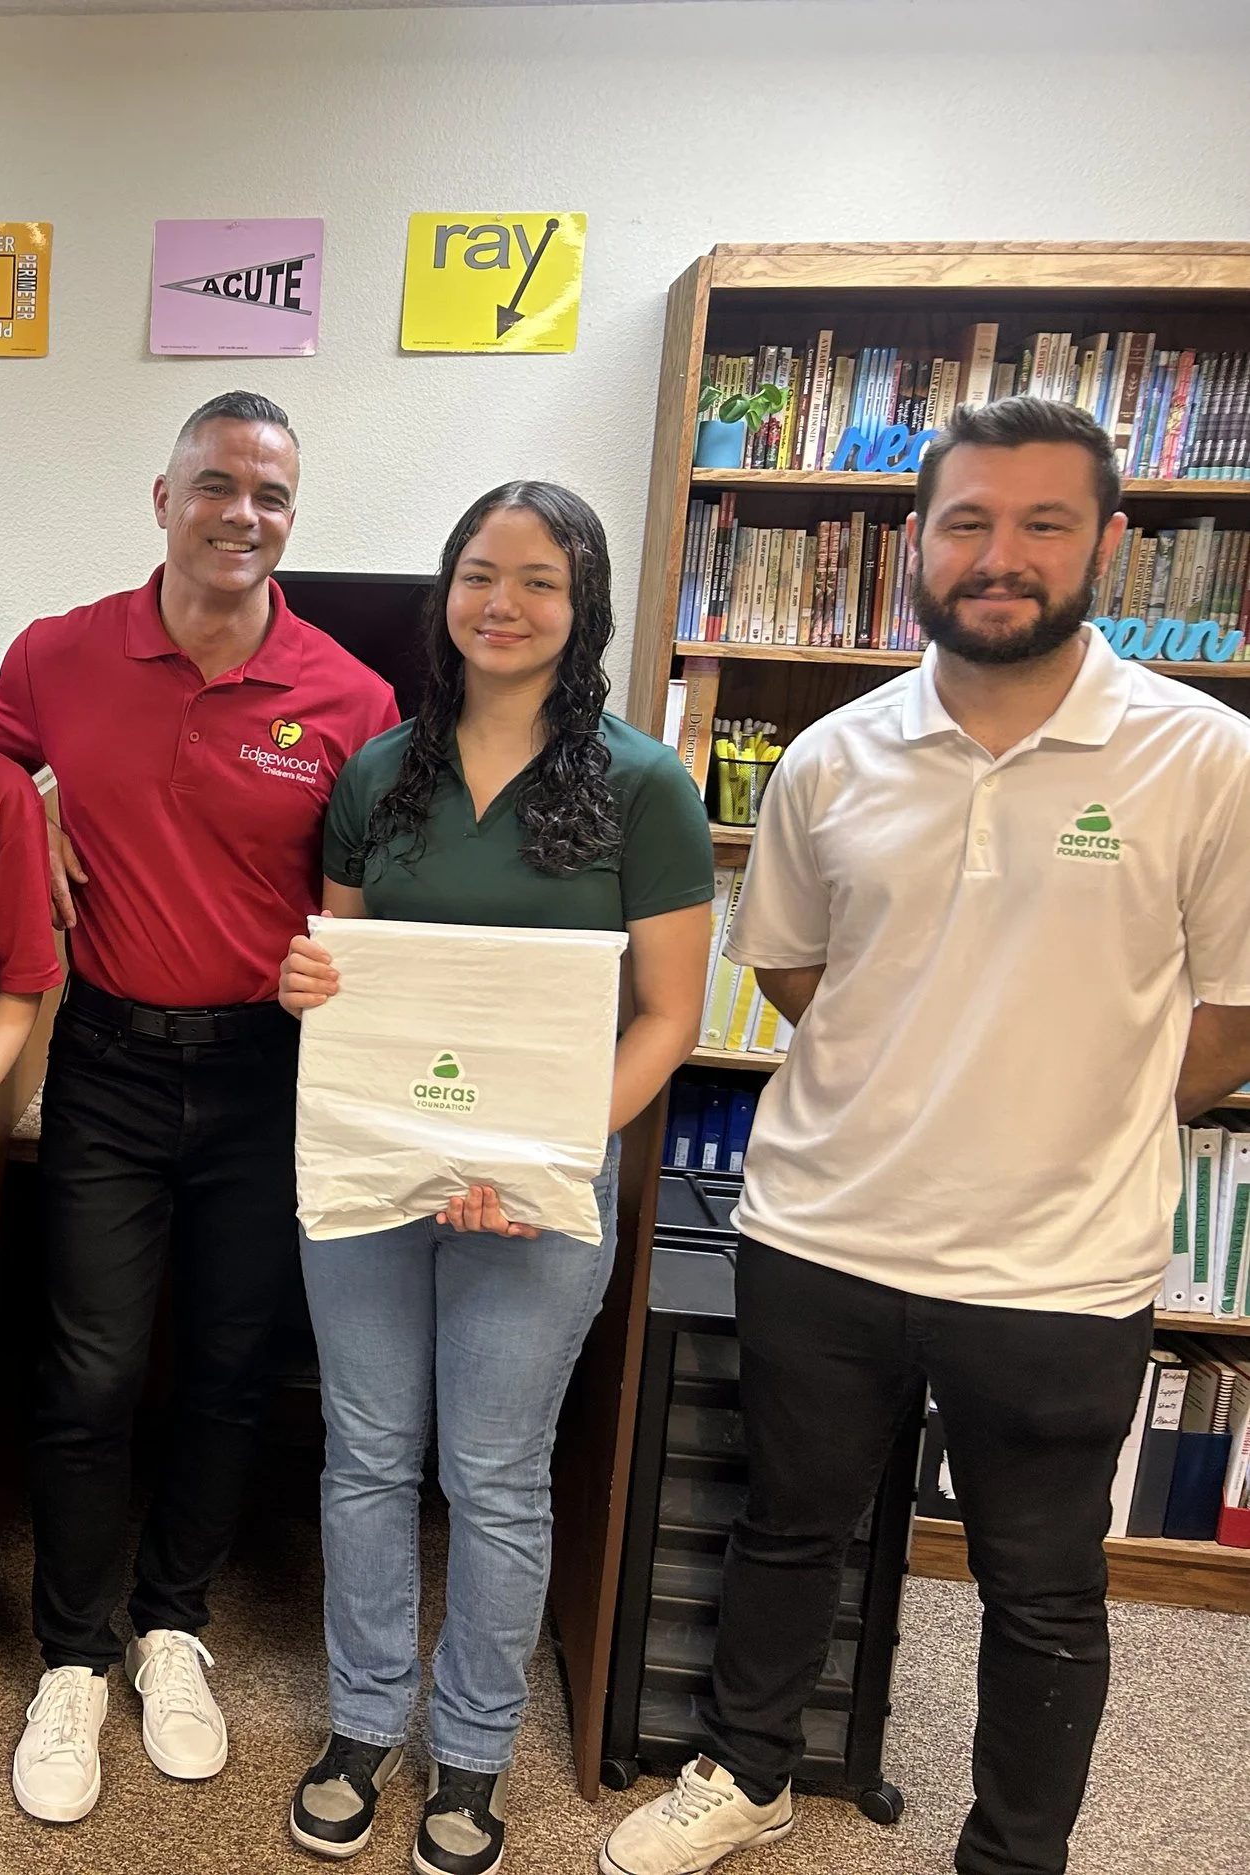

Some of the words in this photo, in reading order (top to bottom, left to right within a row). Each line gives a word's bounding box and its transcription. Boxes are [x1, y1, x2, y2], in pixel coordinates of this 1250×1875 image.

[433, 221, 559, 298] ray
[15, 253, 38, 321] PERIMETER
[201, 259, 304, 310] ACUTE
[932, 363, 941, 386] BILLY
[926, 388, 937, 423] SUNDAY
[708, 528, 716, 548] Choice
[706, 550, 714, 570] Stories
[1140, 550, 1146, 558] UP
[1150, 550, 1156, 558] UP
[1136, 559, 1144, 580] FROM
[1145, 560, 1154, 580] FROM
[1132, 582, 1142, 609] SLAVERY
[1141, 582, 1151, 610] SLAVERY
[239, 743, 320, 774] Edgewood
[262, 766, 295, 780] Children's
[295, 773, 316, 784] Ranch
[1059, 833, 1121, 851] aeras
[1056, 847, 1120, 861] FOUNDATION
[413, 1083, 476, 1103] aeras
[416, 1099, 472, 1112] FOUNDATION
[1197, 1190, 1208, 1228] SOCIAL
[1232, 1218, 1246, 1254] SOCIAL
[1195, 1233, 1207, 1277] STUDIES
